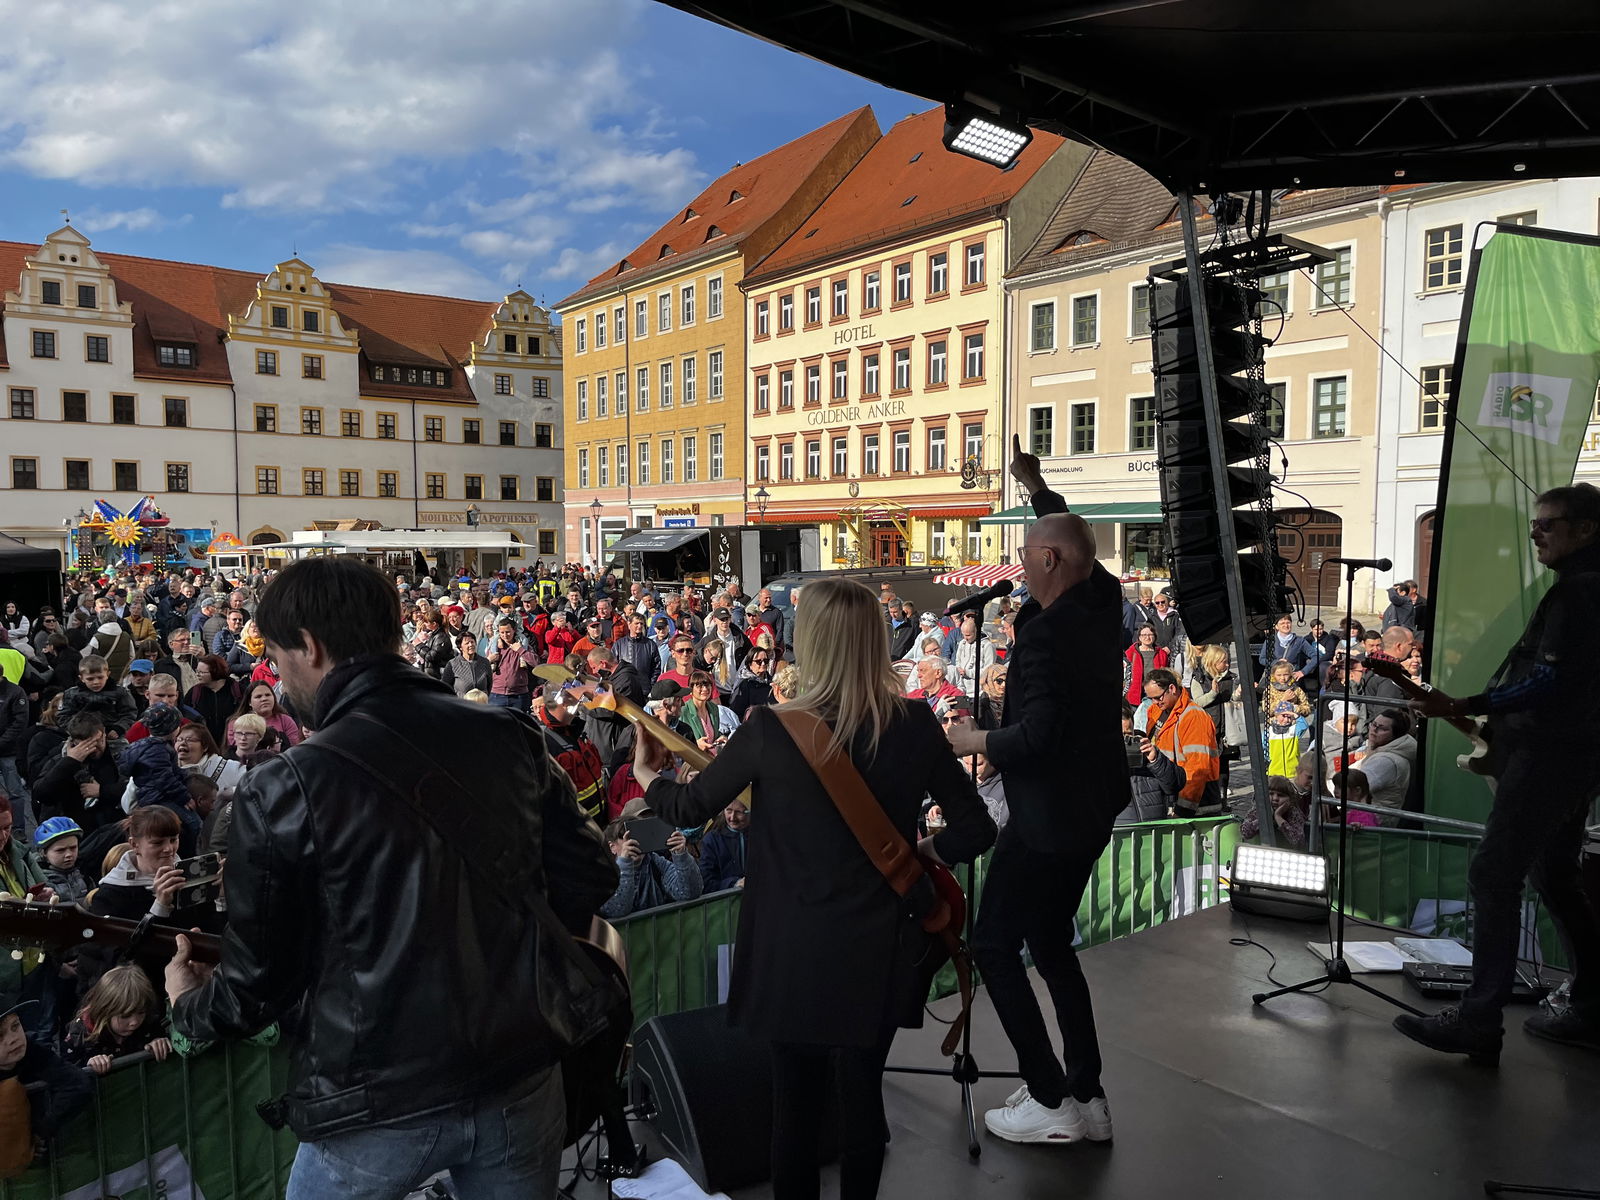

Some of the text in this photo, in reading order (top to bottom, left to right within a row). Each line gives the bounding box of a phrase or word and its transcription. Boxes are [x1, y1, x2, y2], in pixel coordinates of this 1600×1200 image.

[834, 324, 876, 345] HOTEL
[808, 400, 906, 425] GOLDENER ANKER
[1492, 386, 1504, 417] RADIO
[480, 514, 537, 523] APOTHEKE
